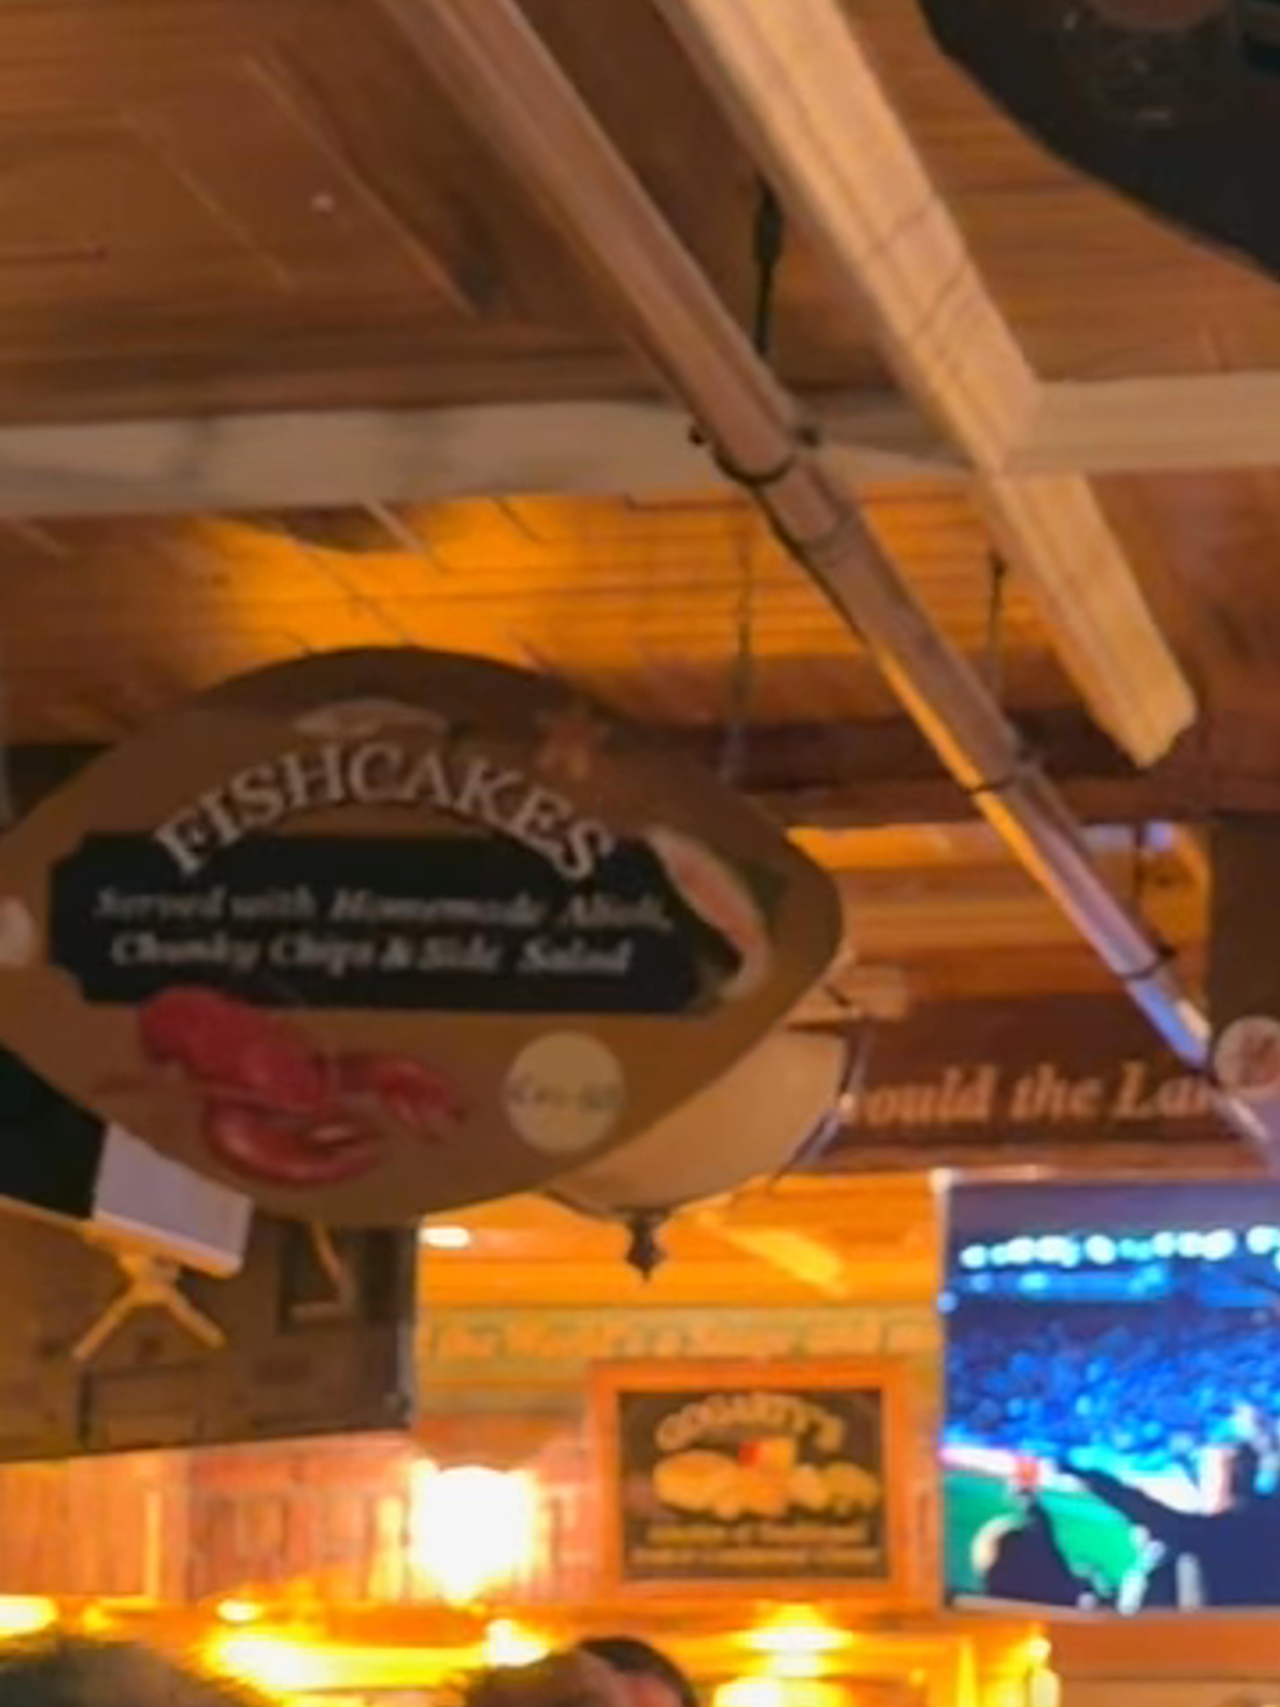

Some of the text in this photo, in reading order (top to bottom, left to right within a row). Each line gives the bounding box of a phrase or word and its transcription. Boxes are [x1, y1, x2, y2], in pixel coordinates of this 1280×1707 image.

[153, 740, 614, 881] FISHCAKES
[92, 886, 227, 921] Served
[231, 886, 317, 922] with
[267, 934, 376, 977] Chips
[1011, 1059, 1101, 1123] the
